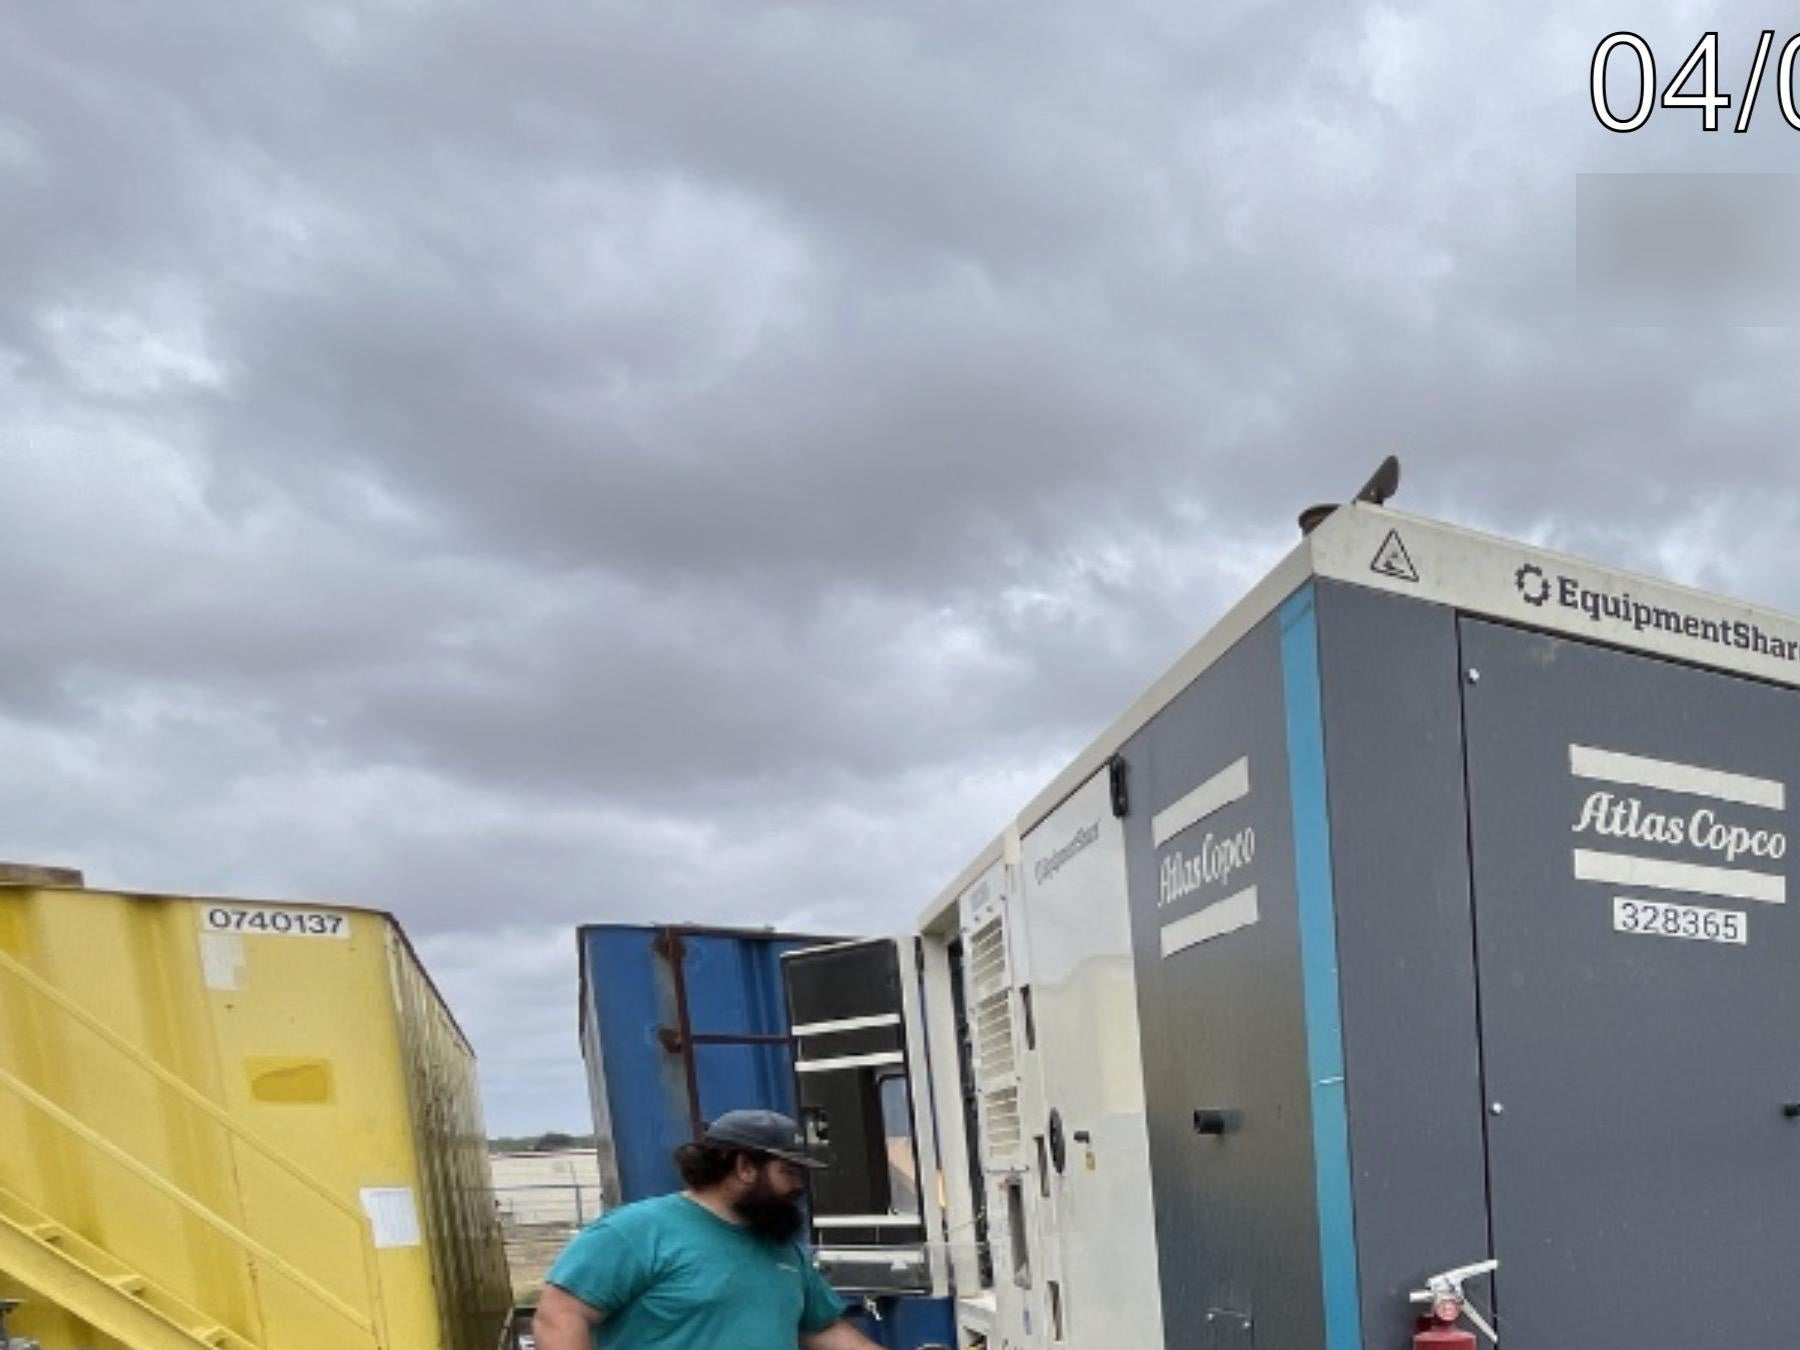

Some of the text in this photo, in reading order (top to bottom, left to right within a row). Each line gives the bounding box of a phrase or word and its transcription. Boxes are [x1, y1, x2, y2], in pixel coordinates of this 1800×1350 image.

[1572, 792, 1786, 862] Atlas Copco
[209, 908, 343, 934] 0740137
[1621, 902, 1738, 939] 328365
